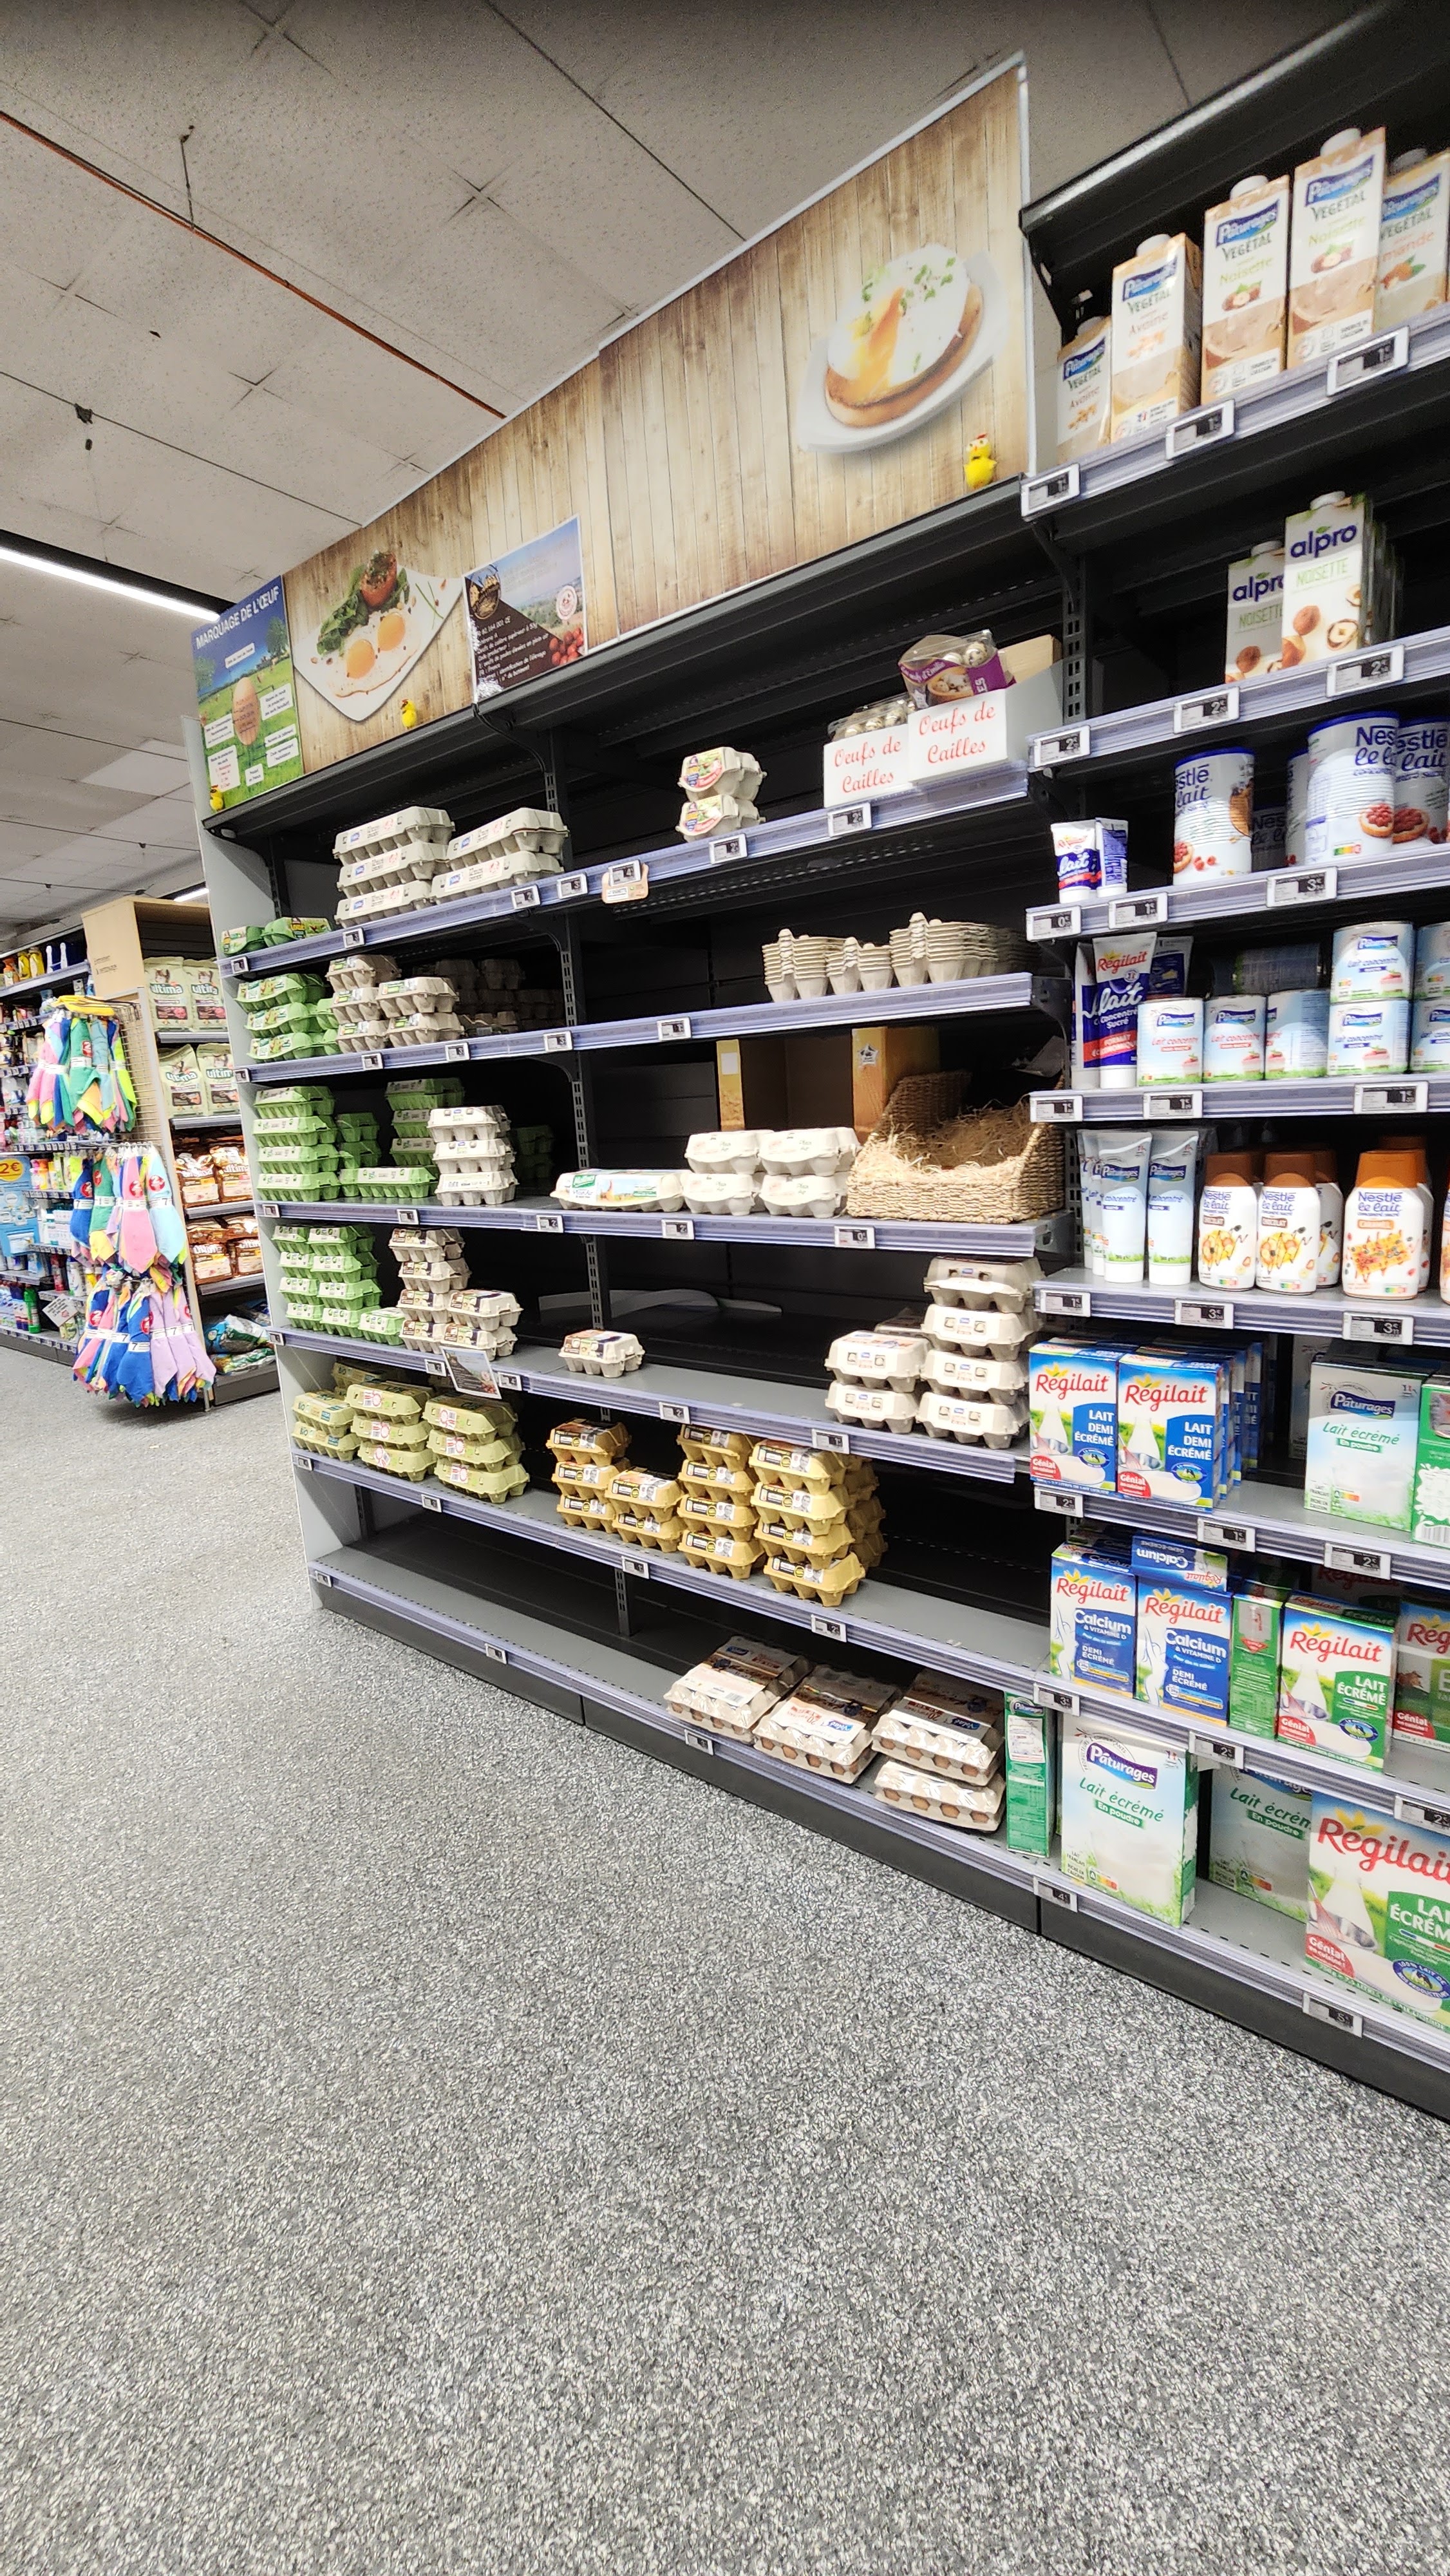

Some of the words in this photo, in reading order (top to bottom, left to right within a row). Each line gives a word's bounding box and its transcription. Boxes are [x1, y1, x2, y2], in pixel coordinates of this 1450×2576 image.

[1290, 524, 1357, 558] alpro
[195, 612, 240, 650] MARQUAGE
[240, 605, 253, 622] DE
[974, 701, 996, 723] de
[882, 735, 901, 755] de
[927, 737, 986, 764] Cailles
[842, 768, 894, 793] Cailles
[1057, 852, 1091, 876] lait
[1097, 951, 1148, 974] Régilait
[150, 982, 183, 994] ultima
[1098, 981, 1144, 1017] lait
[205, 1068, 233, 1079] ultim
[1103, 1164, 1139, 1178] Pâturages
[1149, 1164, 1185, 1177] Pâturages
[1357, 1191, 1403, 1202] Nestlé
[1035, 1373, 1109, 1400] Régilait
[1125, 1384, 1209, 1412] Régilait
[1334, 1392, 1393, 1416] Pâturages
[1089, 1409, 1114, 1423] LAIT
[1074, 1431, 1114, 1447] ÉCRÉMÉ
[1088, 1423, 1114, 1435] DEMI
[1185, 1421, 1214, 1435] LAIT
[1323, 1421, 1350, 1435] Lait
[1350, 1425, 1401, 1446] écrémé
[1167, 1444, 1212, 1461] ÉCRÉMÉ
[1183, 1435, 1212, 1449] DEMI
[1339, 1438, 1350, 1446] En
[1350, 1440, 1380, 1452] poudre
[1031, 1457, 1056, 1469] Génial
[1120, 1473, 1146, 1486] Génial
[1136, 1547, 1189, 1569] Calcium
[1057, 1578, 1131, 1604] Régilait
[1074, 1610, 1131, 1634] Calcium
[1145, 1597, 1225, 1625] Régilait
[1089, 1625, 1120, 1639] VITAMINE
[1082, 1645, 1102, 1656] DEMI
[1165, 1629, 1227, 1658] Calcium
[1290, 1631, 1383, 1663] Régilait
[1082, 1651, 1115, 1666] ÉCRÉMÉ
[1182, 1647, 1214, 1663] VITAMINE
[1172, 1668, 1194, 1680] DEMI
[1172, 1675, 1208, 1691] ÉCRÉMÉ
[1355, 1674, 1388, 1691] LAIT
[1337, 1681, 1386, 1706] ÉCRÉMÉ
[1281, 1717, 1310, 1734] Génial
[1397, 1712, 1428, 1727] Génial
[1090, 1744, 1156, 1784] Pâturages
[1079, 1776, 1106, 1798] Lait
[1109, 1790, 1165, 1823] écrémé
[1230, 1786, 1262, 1808] Lait
[1263, 1801, 1312, 1830] écrém
[1097, 1802, 1108, 1812] En
[1108, 1806, 1141, 1826] poudre
[1251, 1812, 1263, 1823] En
[1264, 1817, 1301, 1839] poudre
[1389, 1903, 1450, 1943] ÉCRÉM
[1417, 1898, 1450, 1926] LAI
[1308, 1936, 1346, 1961] Génial
[1308, 1945, 1319, 1955] en
[1319, 1950, 1341, 1965] cuisine
